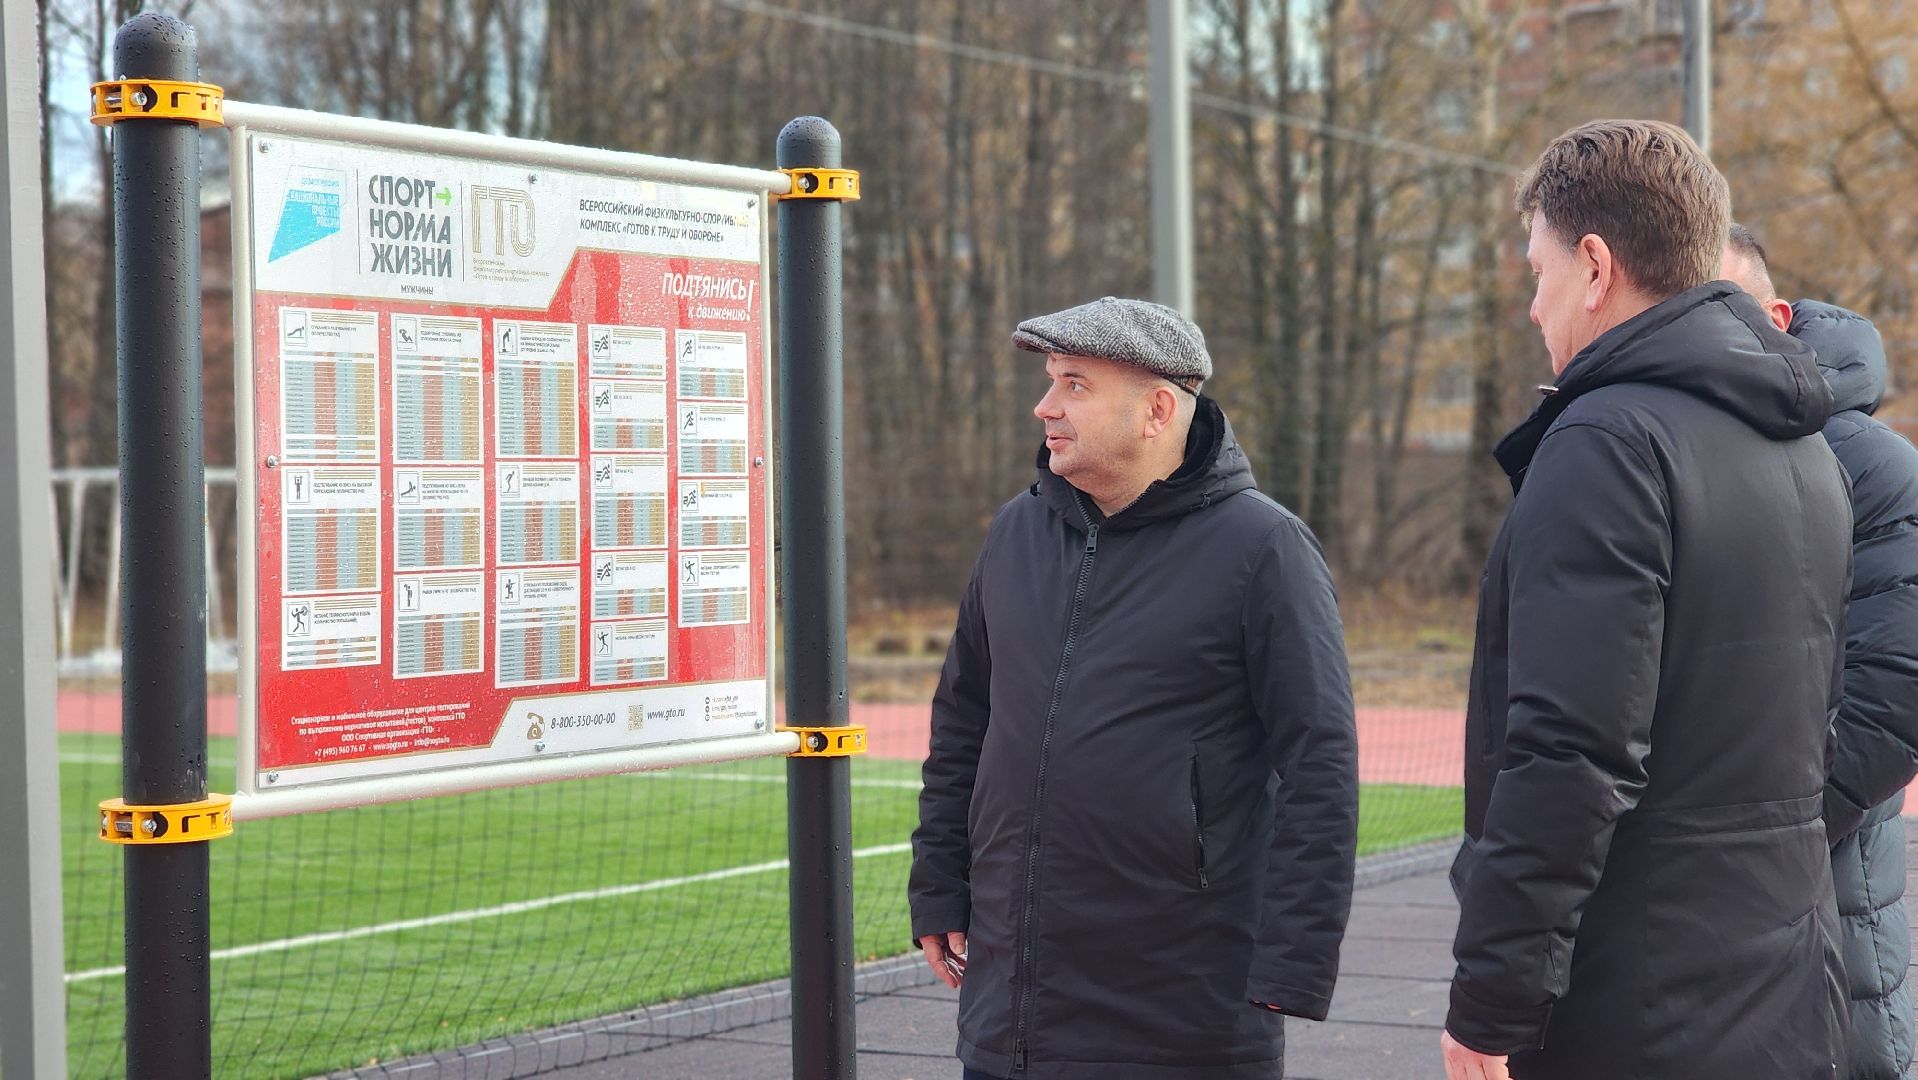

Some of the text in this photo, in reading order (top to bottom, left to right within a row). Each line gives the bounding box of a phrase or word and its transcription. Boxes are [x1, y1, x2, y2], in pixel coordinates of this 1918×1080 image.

[369, 175, 435, 209] СПОРТ
[471, 185, 535, 257] ГТО
[579, 199, 748, 228] ВСЕРОССИЙСКИЙ ФИЗКУЛЬТУРНО-СПОРТИВ
[370, 208, 450, 244] НОРМА
[580, 218, 621, 233] КОМПЛЕКС
[658, 226, 680, 240] ТРУДУ
[682, 229, 687, 239] И
[371, 242, 451, 278] ЖИЗНИ
[401, 284, 433, 295] МУЖЧИНЫ
[688, 303, 746, 320] к движению
[455, 712, 466, 720] ГТО
[648, 708, 686, 721] www.gto.ru
[341, 733, 355, 742] ООО
[323, 747, 337, 757] (495)
[351, 744, 358, 752] 76
